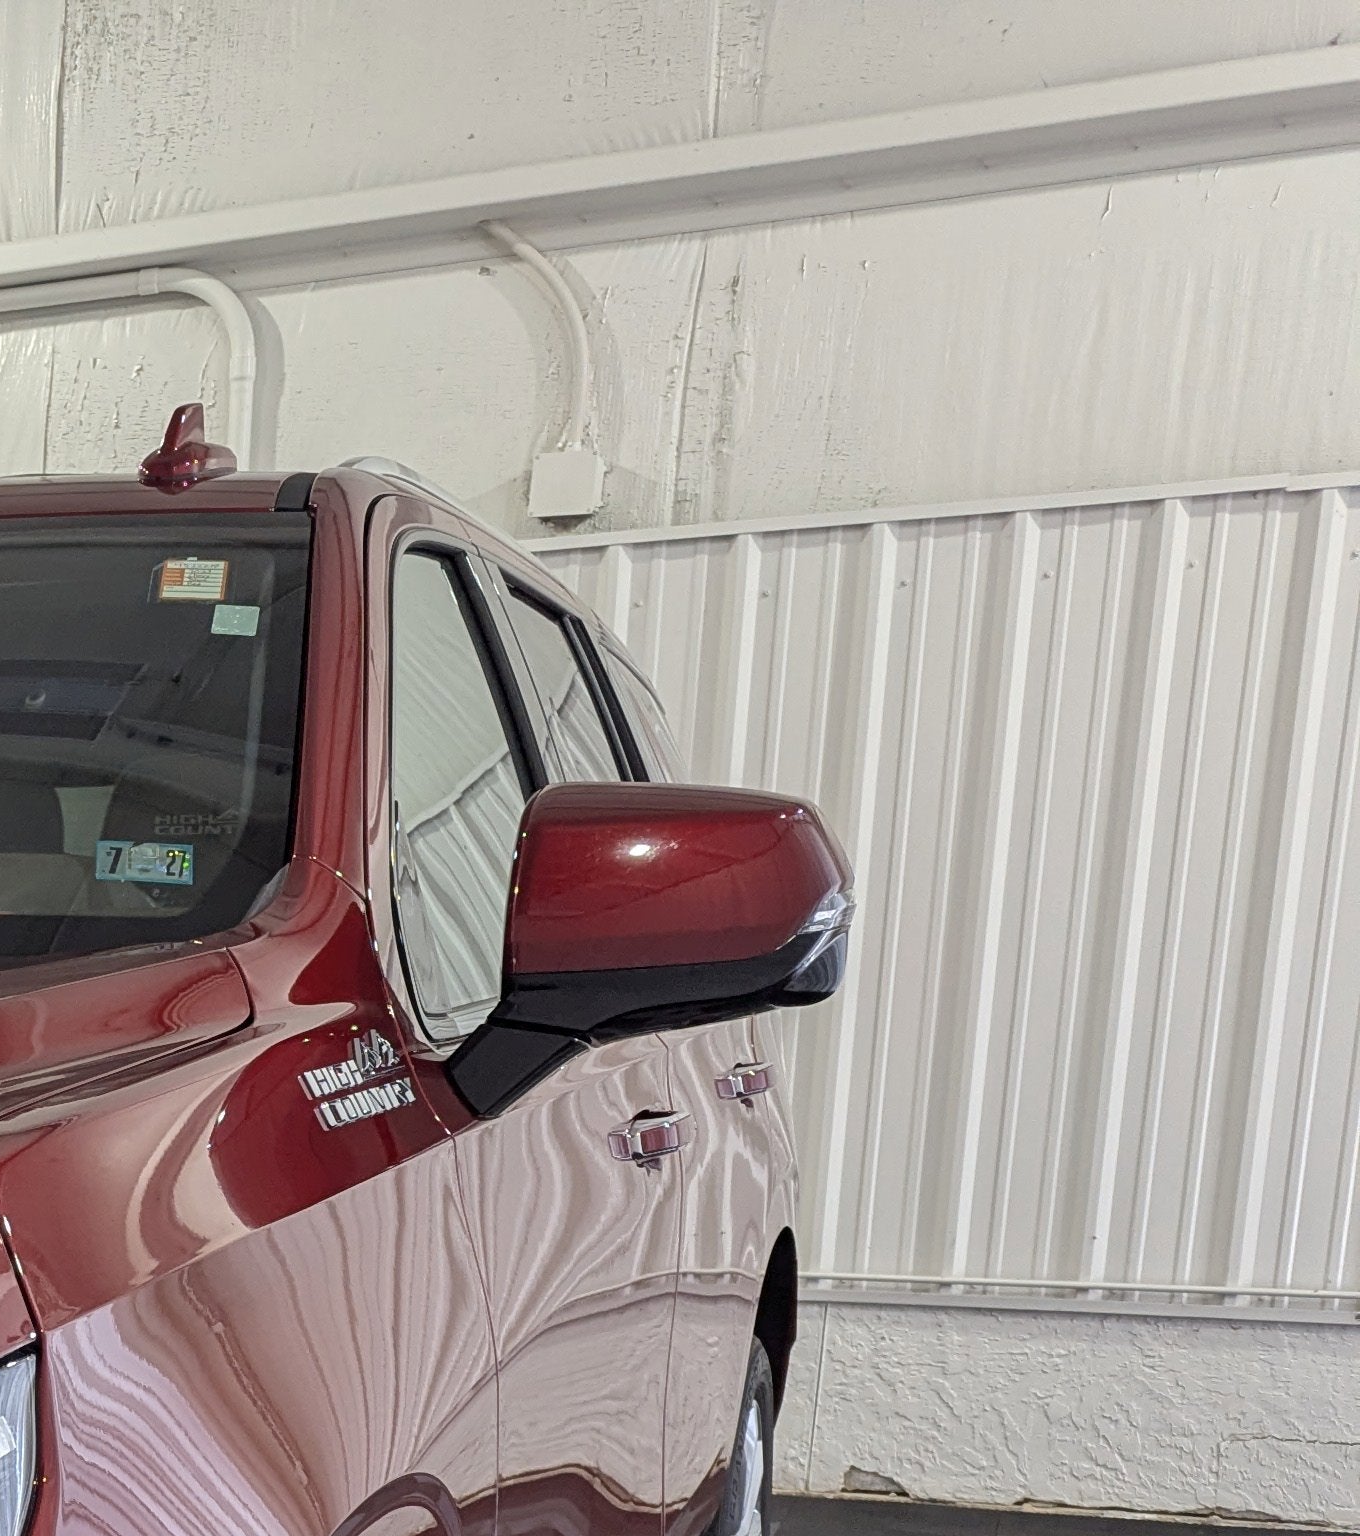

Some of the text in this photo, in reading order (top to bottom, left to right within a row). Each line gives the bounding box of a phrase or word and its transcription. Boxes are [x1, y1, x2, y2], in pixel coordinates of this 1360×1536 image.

[109, 846, 123, 875] 7
[300, 1058, 365, 1098] HIGH
[316, 1077, 417, 1129] COUNTRY
